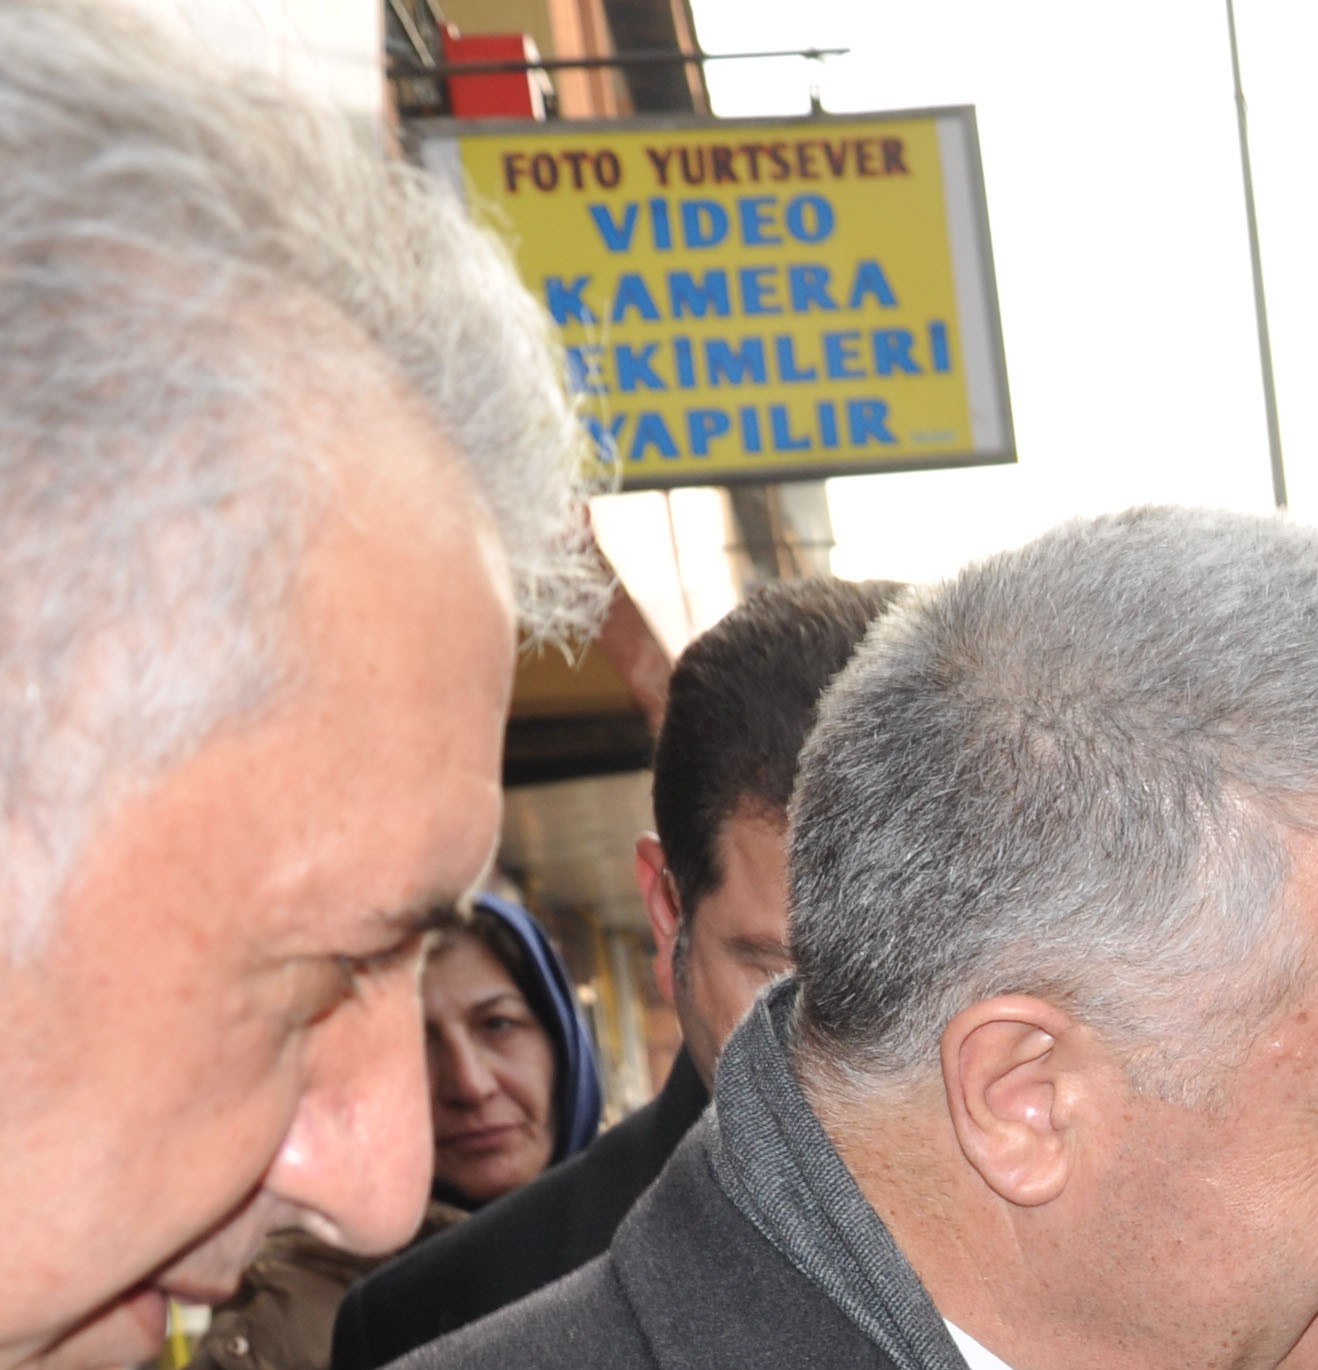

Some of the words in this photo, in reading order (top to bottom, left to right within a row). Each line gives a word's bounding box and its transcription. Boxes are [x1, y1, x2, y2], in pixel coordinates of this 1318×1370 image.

[502, 149, 622, 193] FOTO
[645, 136, 911, 188] YURTSEVER
[588, 192, 836, 253] VİDEO
[543, 258, 901, 326] KAMERA
[566, 319, 954, 394] EKİMLERİ
